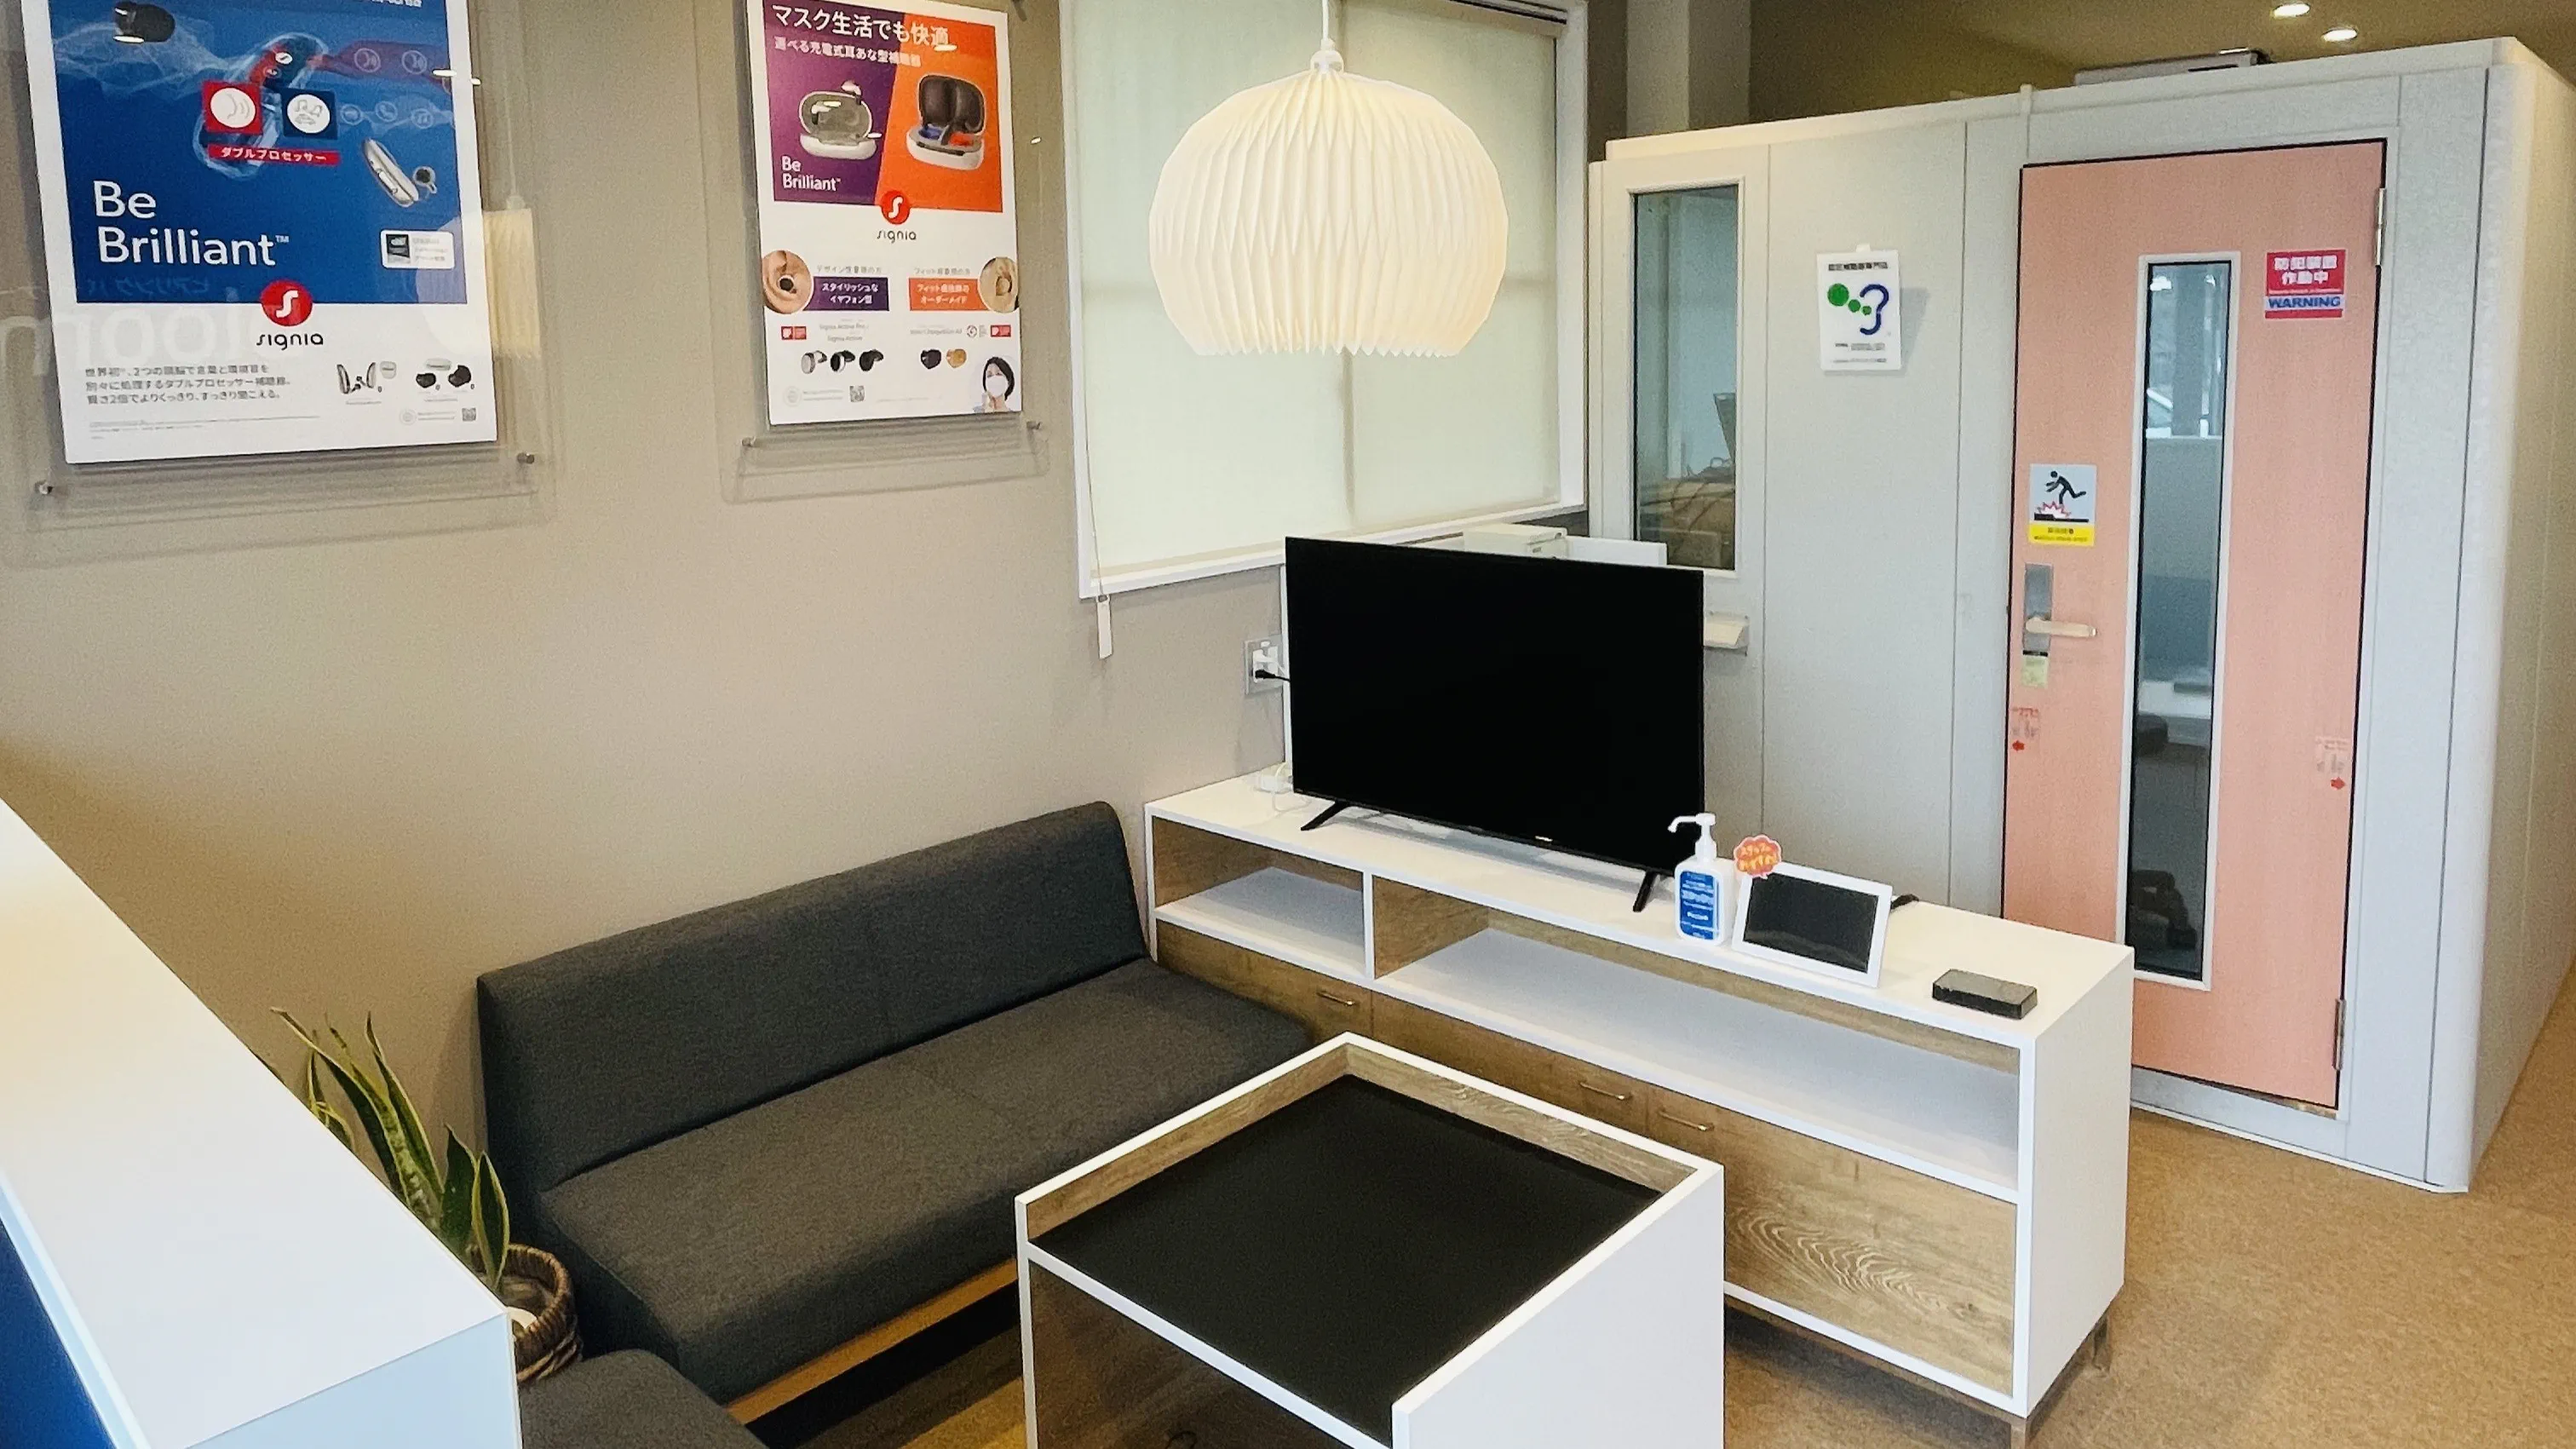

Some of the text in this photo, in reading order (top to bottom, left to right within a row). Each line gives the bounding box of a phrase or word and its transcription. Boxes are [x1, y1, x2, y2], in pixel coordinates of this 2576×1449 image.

[772, 4, 950, 46] マスク生活でも快適
[221, 147, 327, 162] ダブルプロセッサー
[781, 155, 802, 172] Be
[93, 180, 157, 219] Be
[877, 230, 917, 244] signia
[2268, 296, 2341, 308] WARNING
[256, 331, 325, 351] signia
